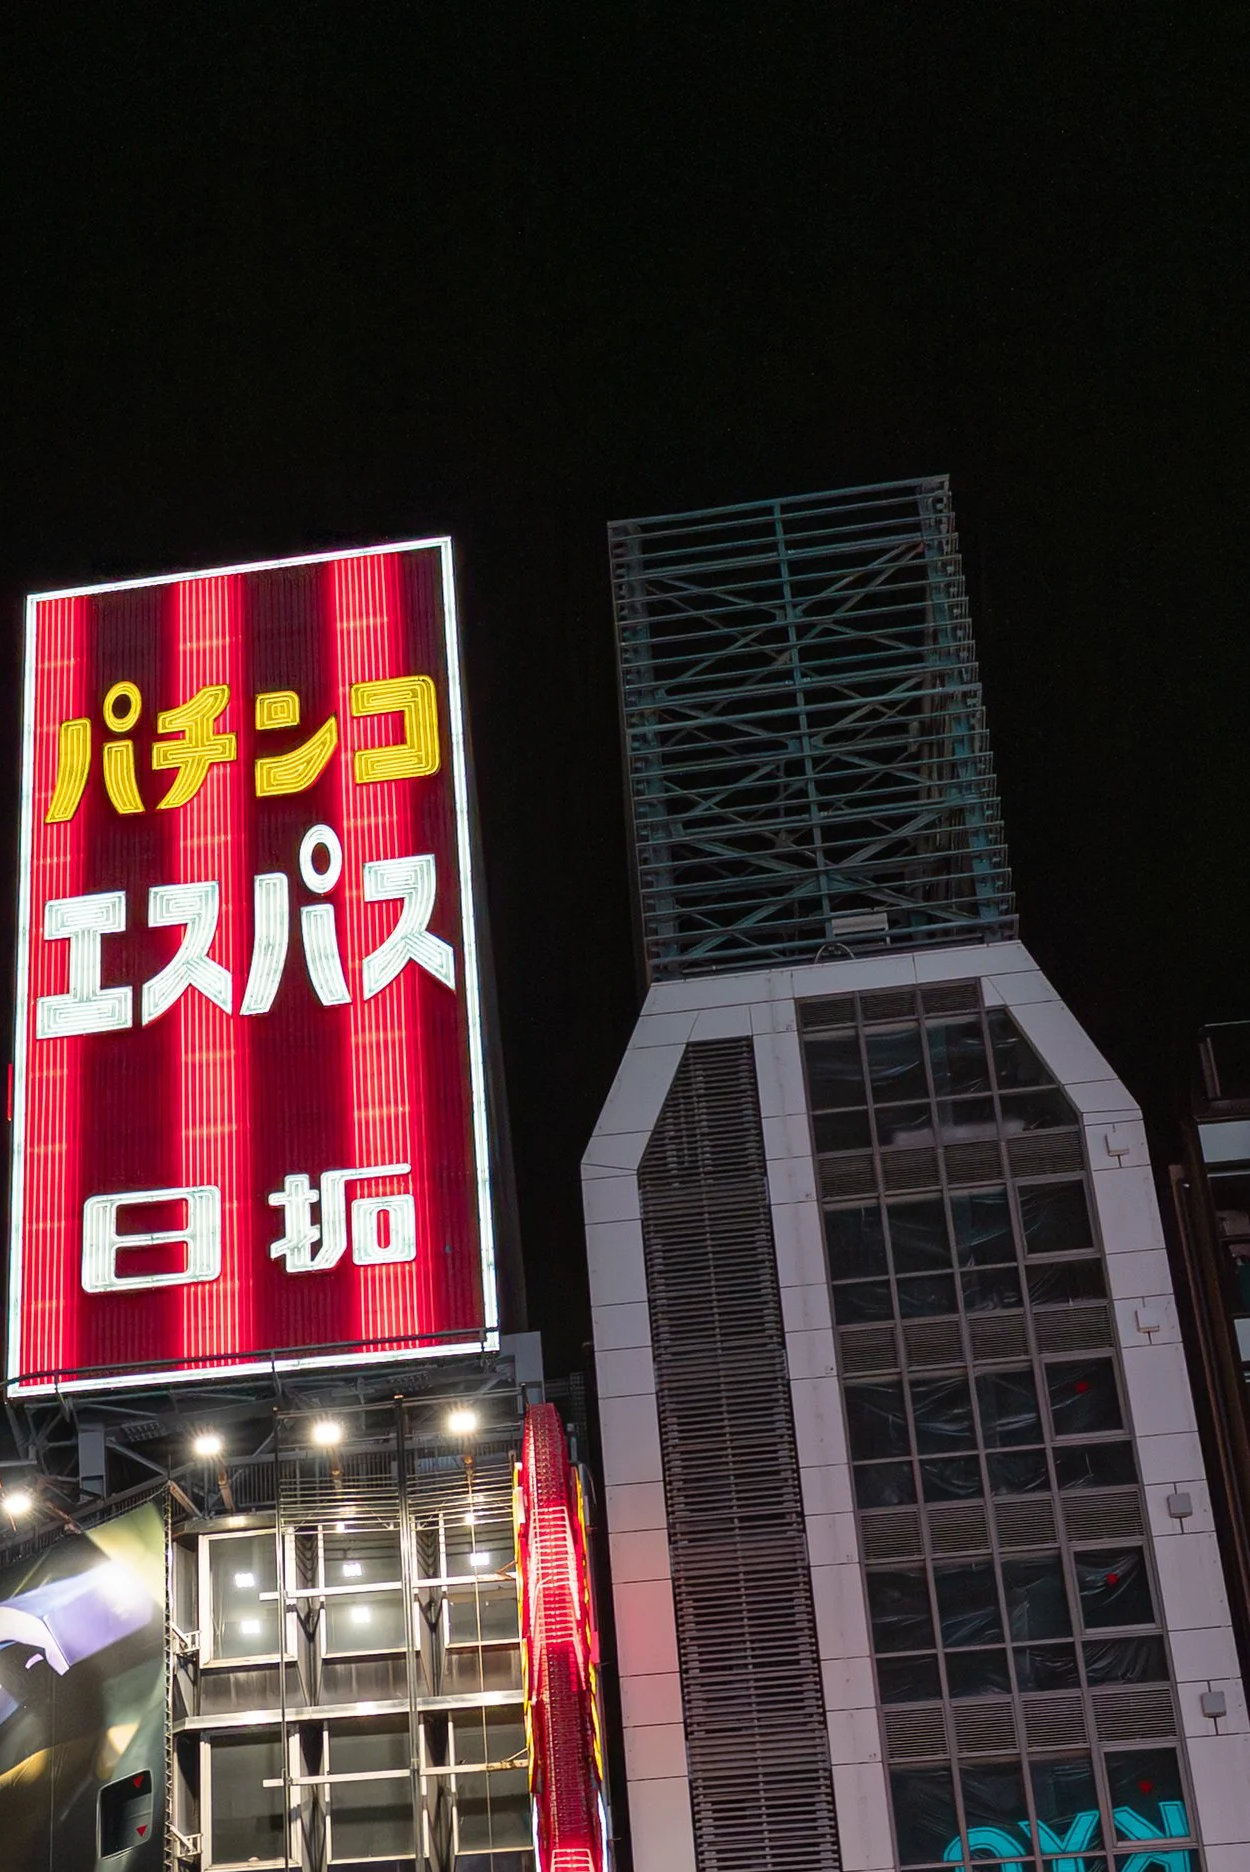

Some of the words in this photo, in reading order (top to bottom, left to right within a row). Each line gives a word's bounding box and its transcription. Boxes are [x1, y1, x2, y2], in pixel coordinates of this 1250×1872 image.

[44, 674, 440, 824] パチンコ
[36, 824, 455, 1041] エスパス
[82, 1162, 417, 1293] 日拓
